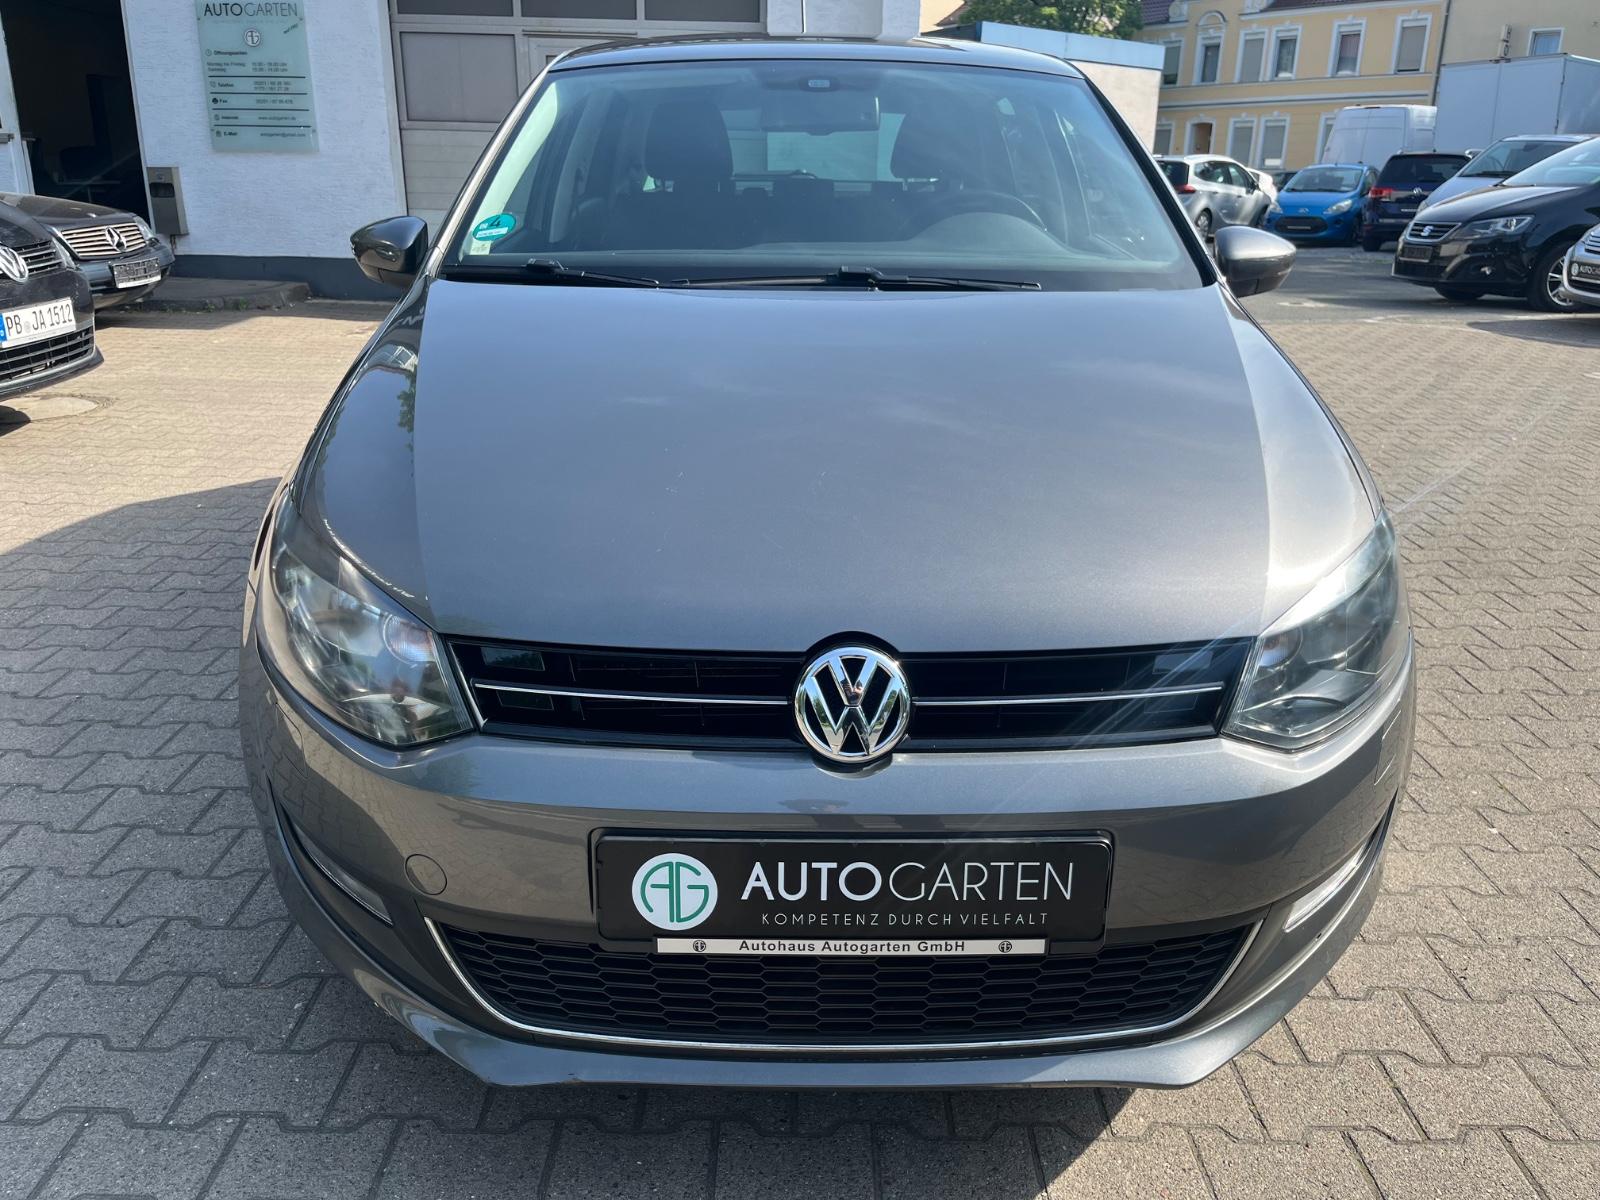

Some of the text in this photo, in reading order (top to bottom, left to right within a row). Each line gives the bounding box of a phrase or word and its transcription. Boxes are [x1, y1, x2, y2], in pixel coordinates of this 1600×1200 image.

[204, 3, 298, 17] AUTOGARTEN
[5, 314, 23, 337] PB
[32, 309, 47, 331] JA
[47, 303, 73, 327] 1512
[740, 861, 1073, 902] AUTOGARTEN
[762, 912, 1048, 926] KOMPETENZ DURCH VIELFALT
[739, 941, 816, 952] Autohaus
[821, 941, 911, 954] Autogarten
[917, 941, 965, 952] GmbH
